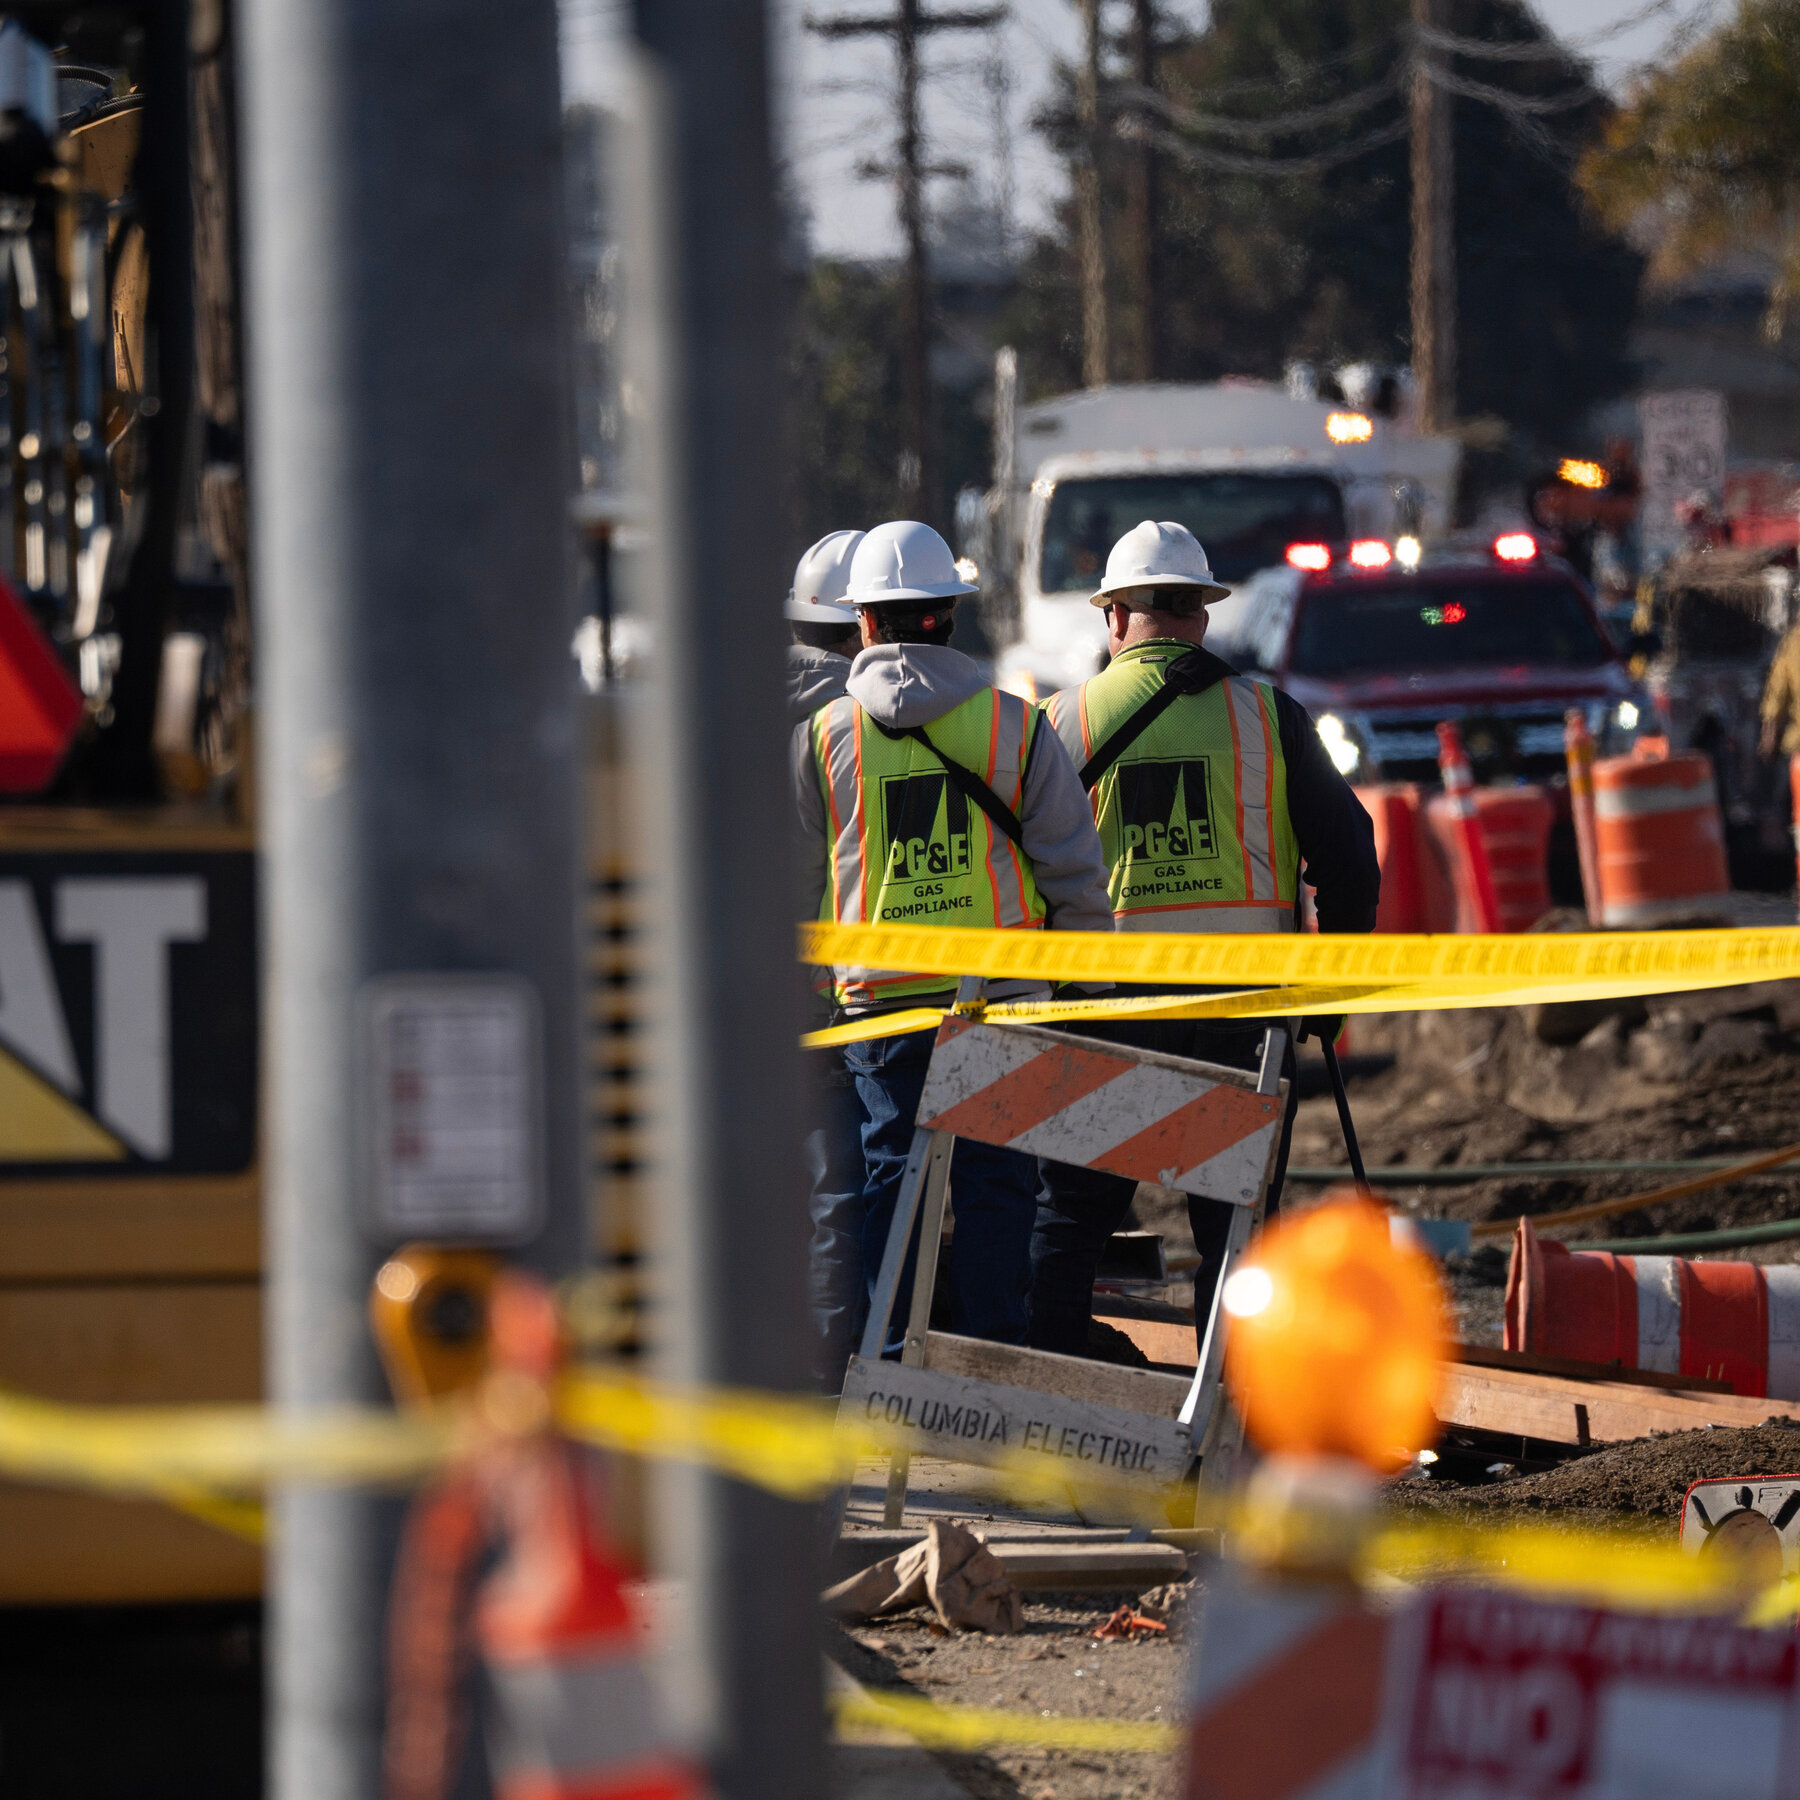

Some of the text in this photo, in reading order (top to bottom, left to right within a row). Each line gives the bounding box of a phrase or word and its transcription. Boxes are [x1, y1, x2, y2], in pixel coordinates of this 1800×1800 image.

[1123, 818, 1214, 861] PG&E
[888, 832, 970, 879] PG&E
[1154, 864, 1186, 879] GAS
[913, 883, 944, 898] GAS
[1121, 878, 1223, 899] COMPLIANCE
[881, 895, 974, 920] COMPLIANCE
[865, 1390, 1159, 1474] COLUMBIA ELECTRIC
